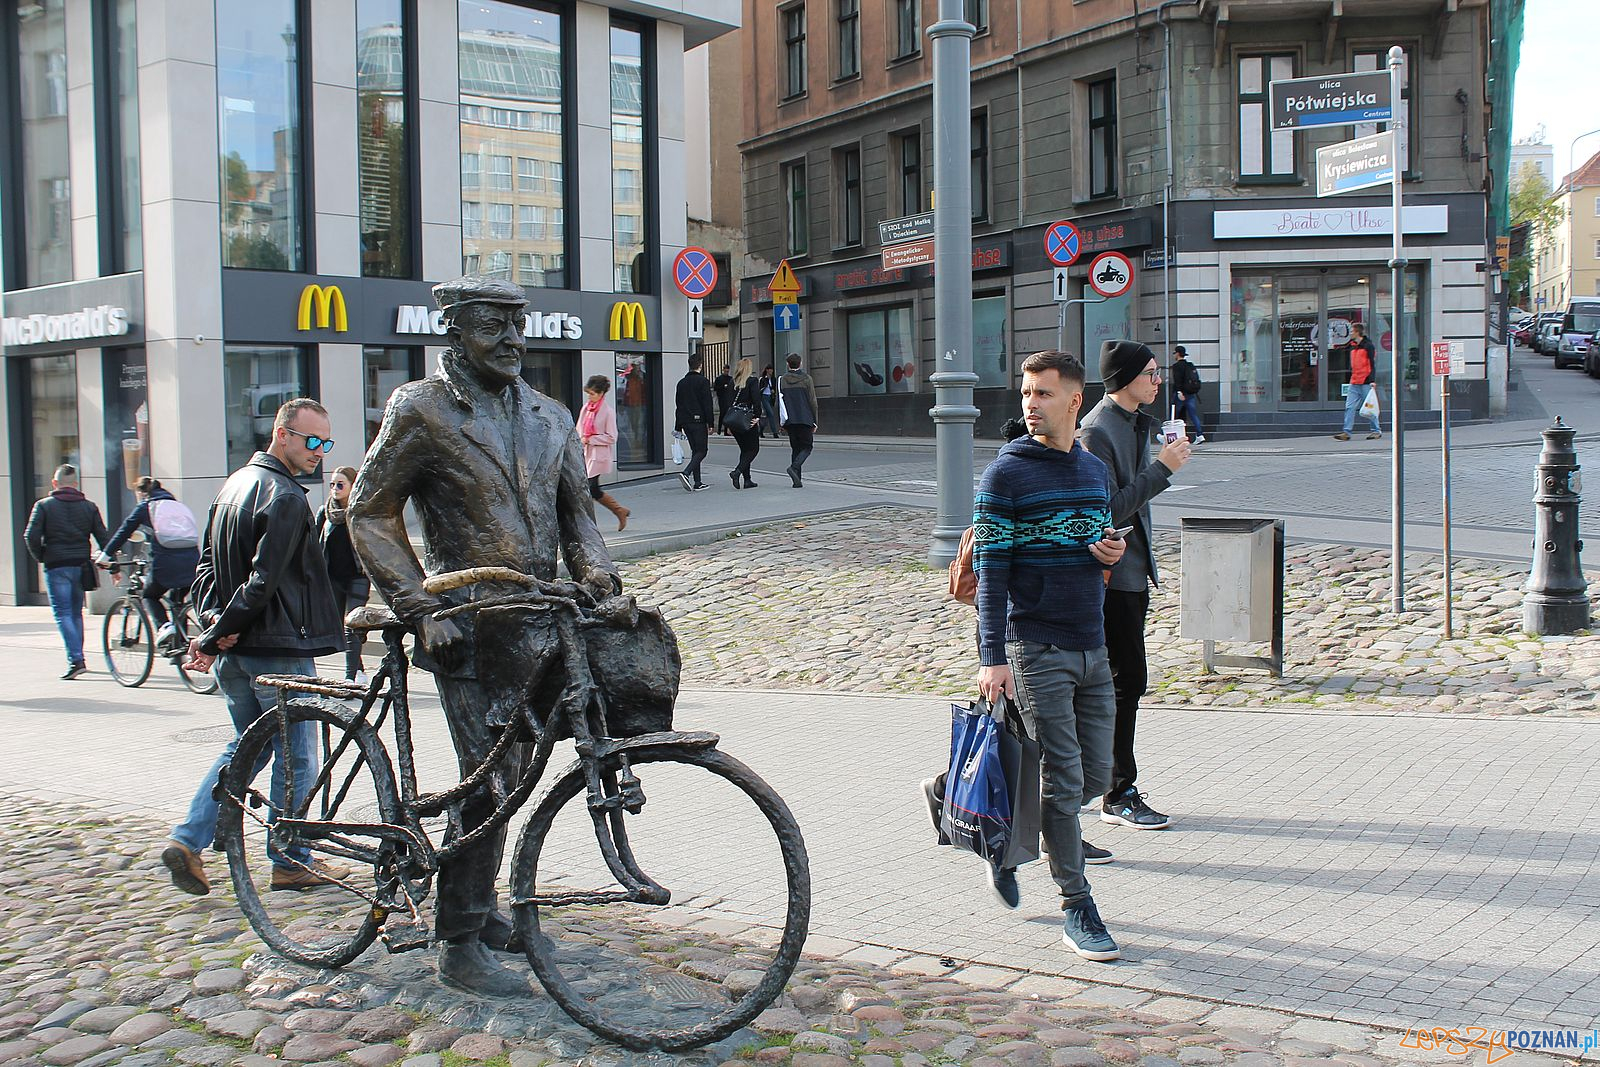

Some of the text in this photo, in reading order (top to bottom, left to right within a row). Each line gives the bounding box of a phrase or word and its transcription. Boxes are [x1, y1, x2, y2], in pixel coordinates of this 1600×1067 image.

[1319, 80, 1341, 89] ulica
[1286, 90, 1377, 112] Półwiejska
[1363, 110, 1391, 118] Centrum
[1324, 153, 1387, 179] Krysiewicza
[1272, 210, 1389, 234] Beate Uhse
[1096, 224, 1125, 243] uhse
[2, 304, 128, 346] McDonald's
